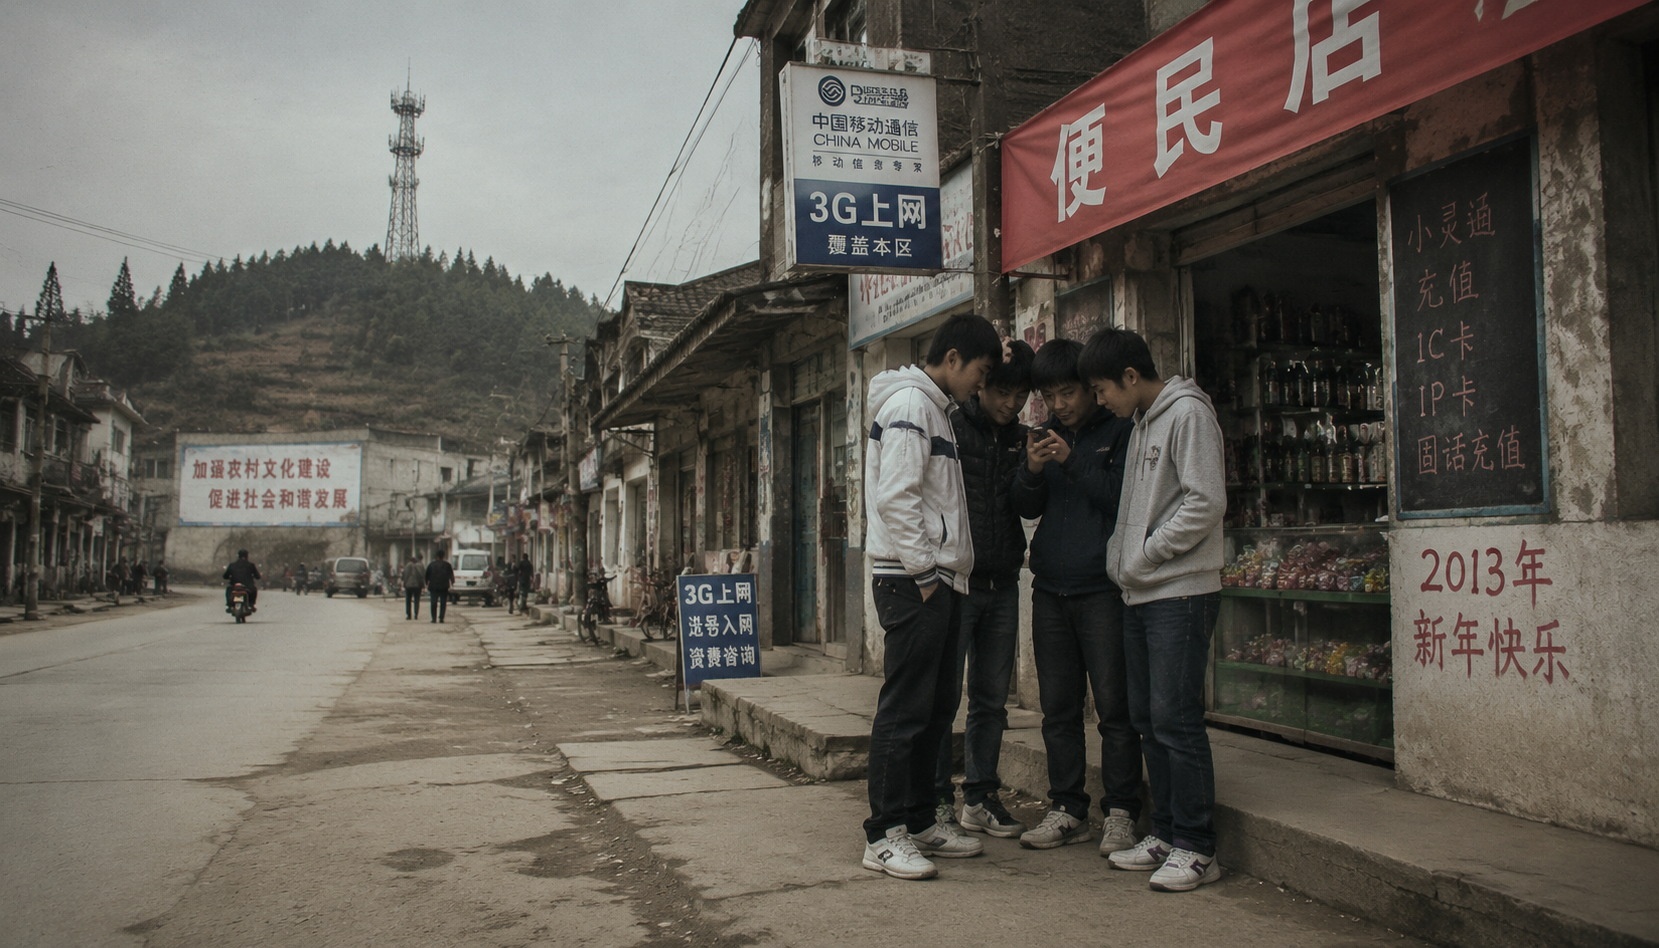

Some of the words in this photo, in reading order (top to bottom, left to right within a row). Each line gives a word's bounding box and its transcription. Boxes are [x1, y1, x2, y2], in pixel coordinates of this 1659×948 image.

[812, 112, 919, 137] 中国移动通信
[1051, 0, 1540, 222] 便民店
[813, 133, 861, 149] CHINA
[867, 137, 919, 153] MOBILE
[809, 190, 926, 229] 3G上网
[1407, 191, 1496, 253] 小灵通
[828, 234, 912, 257] 覆盖本区
[1417, 261, 1479, 312] 充值
[1417, 425, 1526, 474] 固话充值
[208, 488, 348, 510] 促进社会和谐发展
[684, 582, 752, 605] 3G上网
[1420, 539, 1553, 610] 2013年
[1413, 609, 1570, 685] 新年快乐
